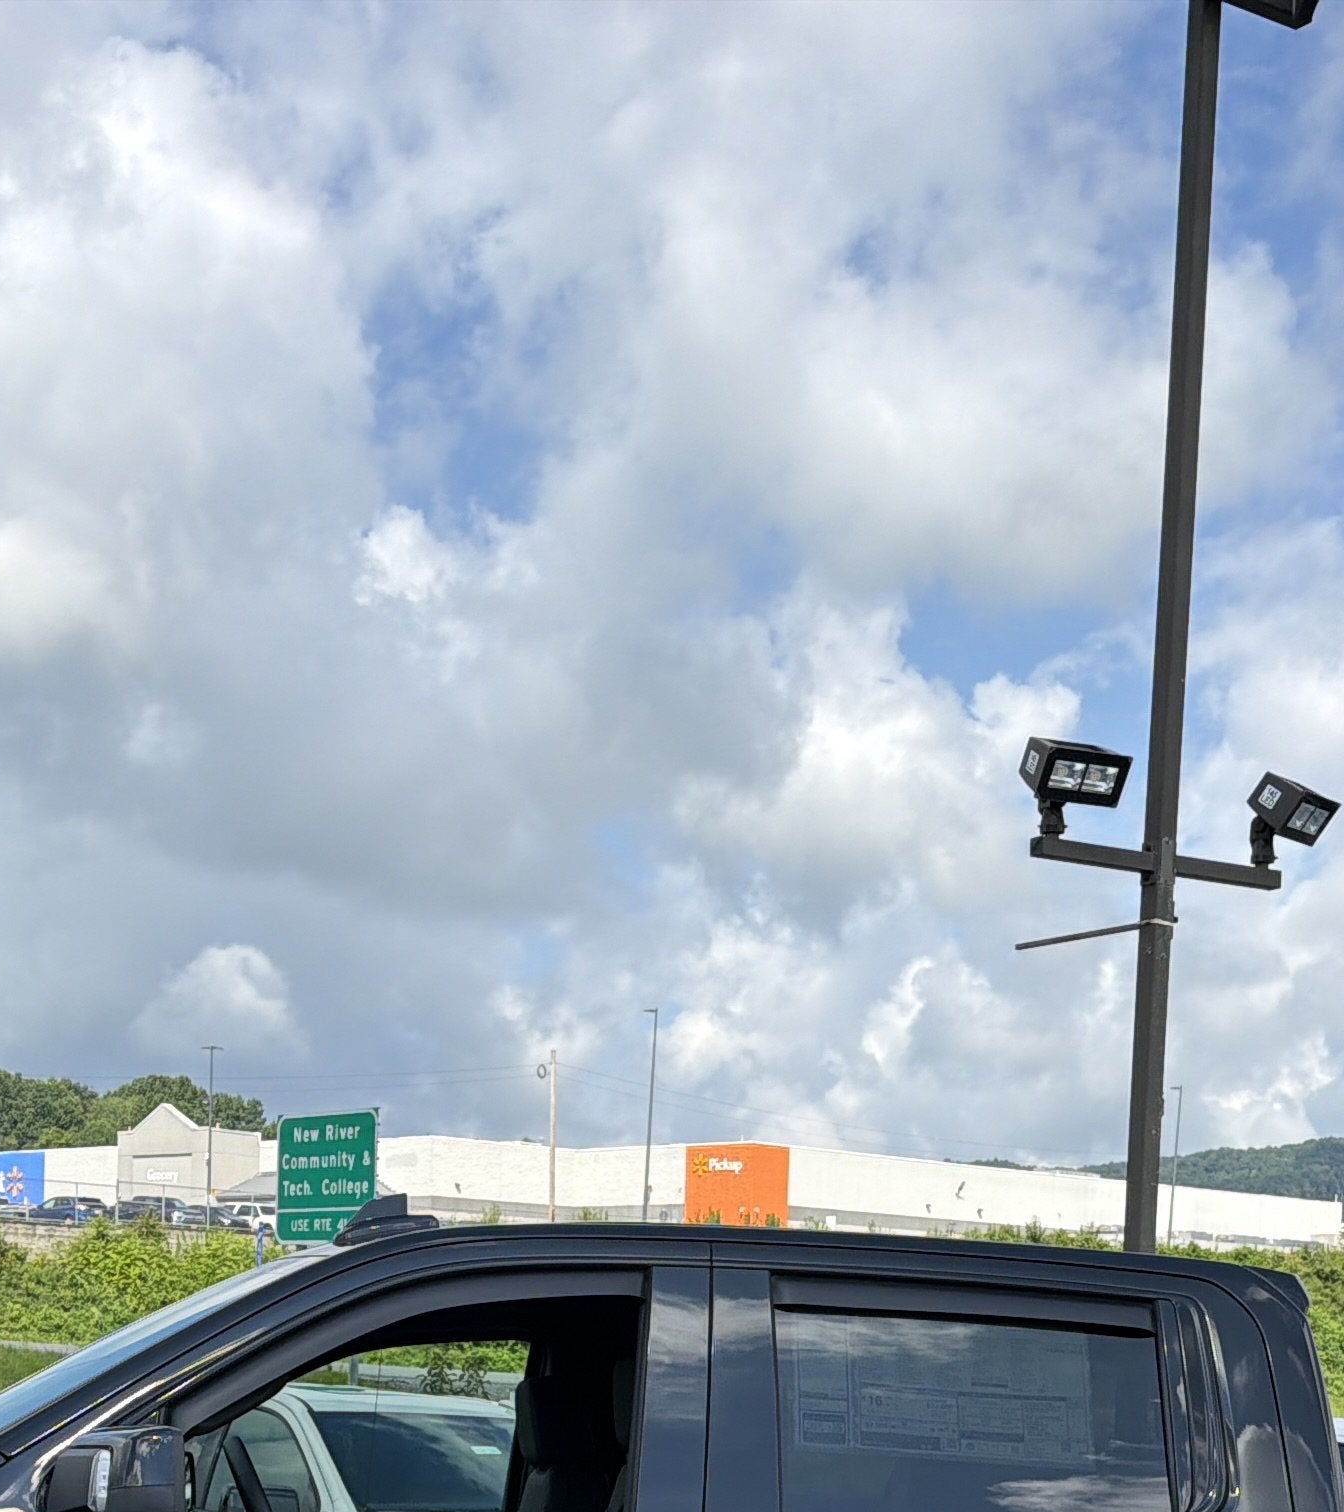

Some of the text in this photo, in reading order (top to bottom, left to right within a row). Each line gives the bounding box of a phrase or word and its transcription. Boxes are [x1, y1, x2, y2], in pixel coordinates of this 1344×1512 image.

[294, 1124, 360, 1143] New River
[282, 1150, 371, 1171] Community &
[283, 1178, 369, 1199] Tech. College
[290, 1219, 310, 1232] USE
[313, 1218, 332, 1232] RTE
